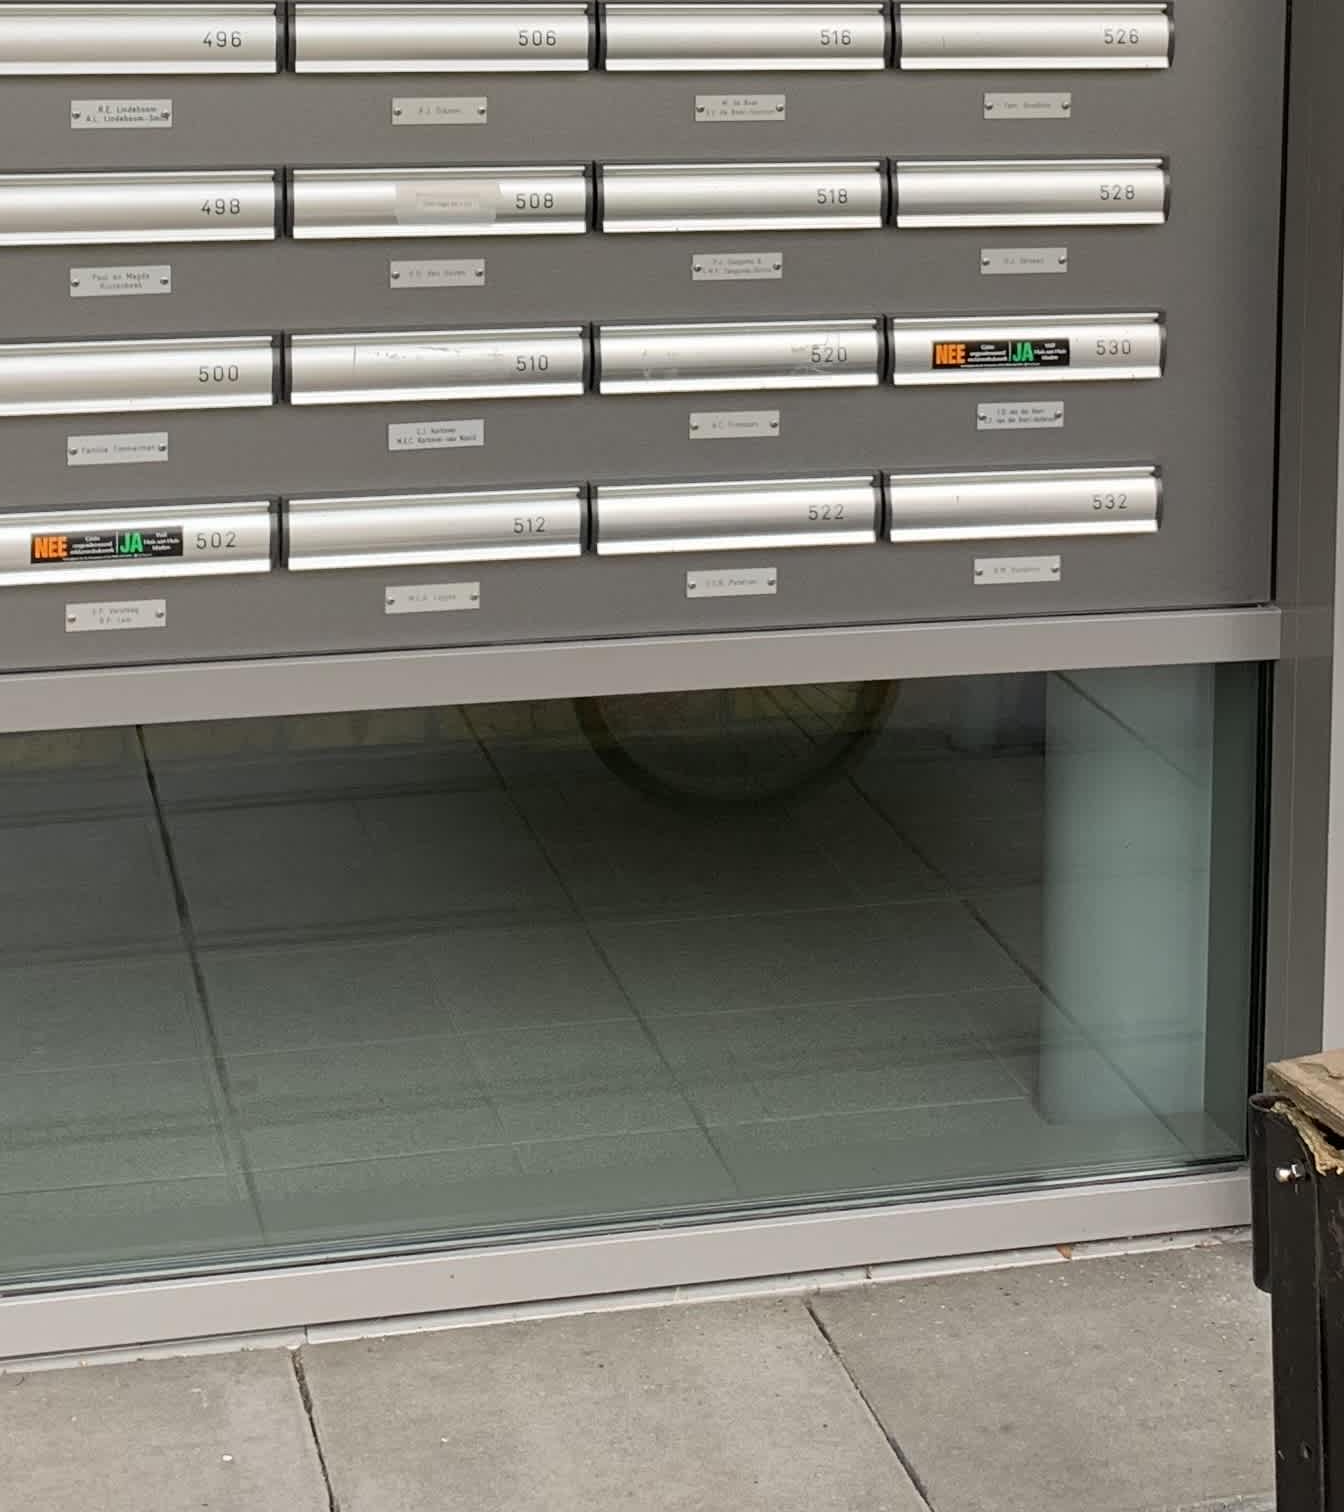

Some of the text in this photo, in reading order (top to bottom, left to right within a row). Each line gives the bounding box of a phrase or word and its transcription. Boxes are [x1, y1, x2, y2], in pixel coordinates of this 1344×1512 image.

[203, 31, 242, 49] 496
[518, 29, 557, 47] 506
[820, 29, 852, 46] 516
[1104, 28, 1139, 45] 526
[515, 192, 554, 210] 508
[816, 188, 848, 205] 518
[1099, 184, 1135, 202] 528
[201, 198, 241, 217] 498
[810, 345, 847, 364] 520
[936, 344, 965, 364] NEE
[1013, 343, 1033, 361] JA
[1096, 339, 1132, 356] 530
[515, 354, 549, 372] 510
[198, 364, 239, 384] 500
[1092, 494, 1128, 511] 532
[808, 504, 844, 521] 522
[513, 517, 547, 535] 512
[34, 535, 68, 558] NEE
[120, 533, 143, 553] JA
[195, 531, 237, 550] 502
